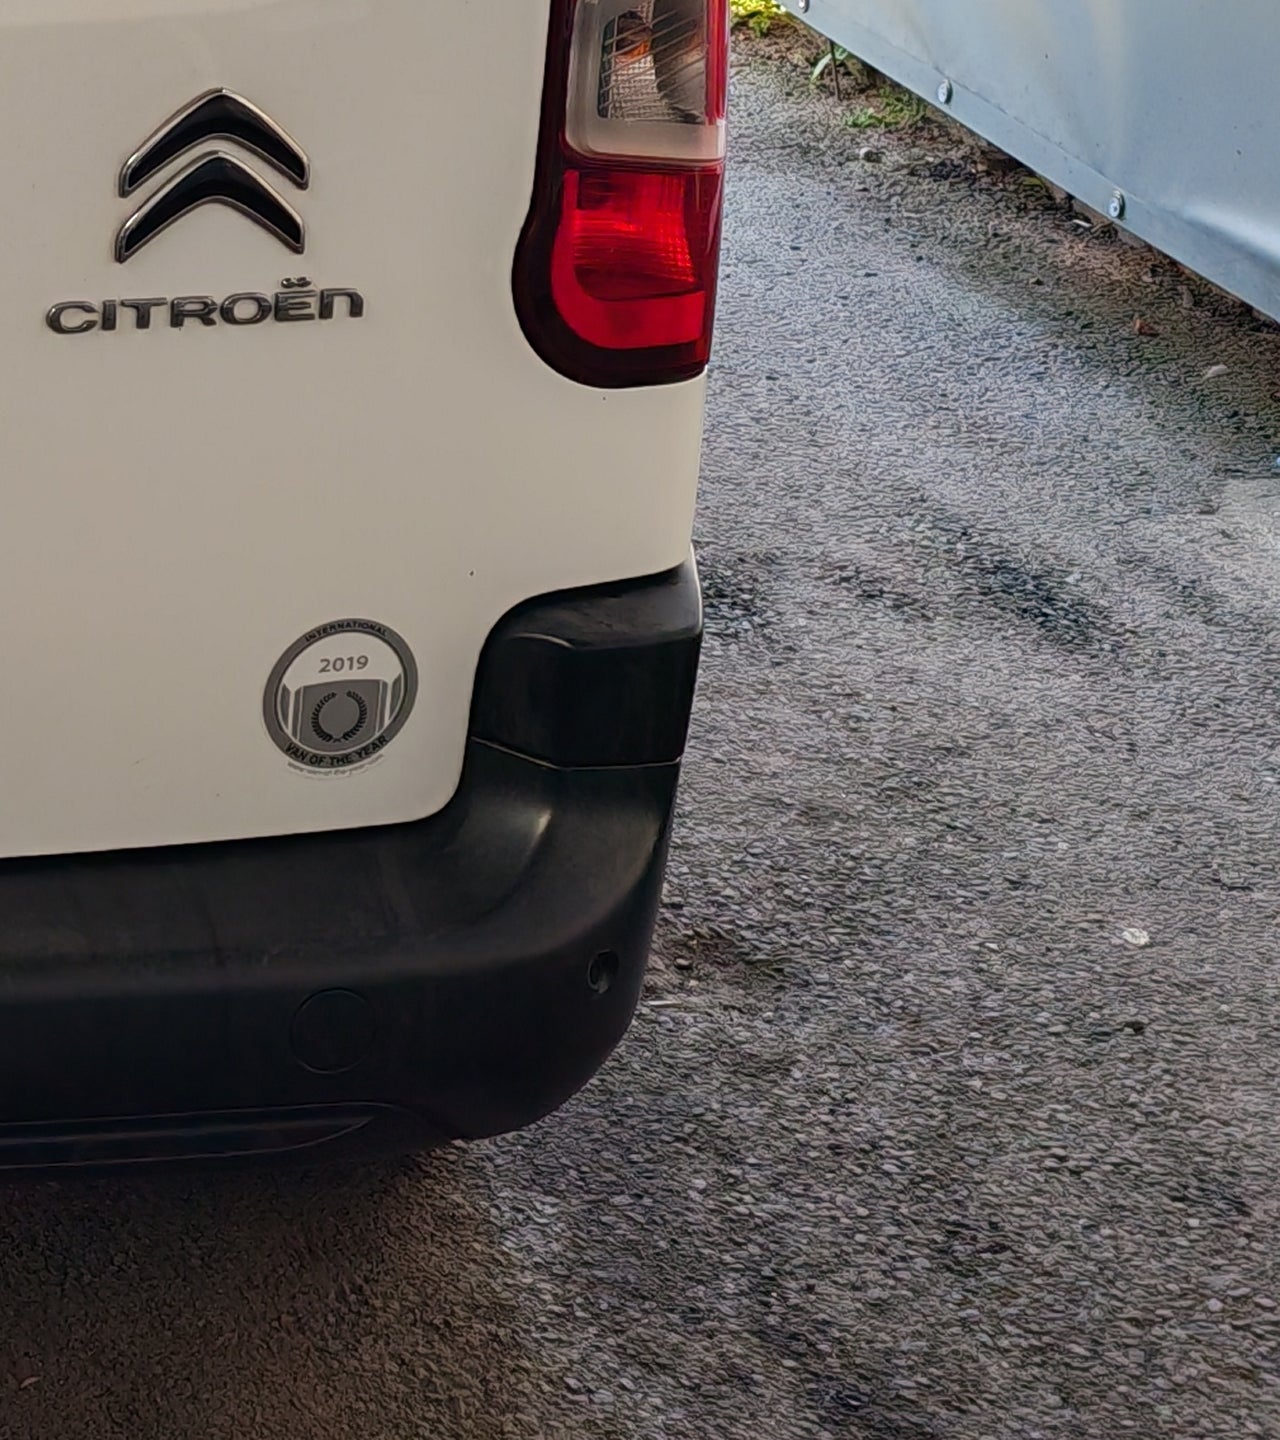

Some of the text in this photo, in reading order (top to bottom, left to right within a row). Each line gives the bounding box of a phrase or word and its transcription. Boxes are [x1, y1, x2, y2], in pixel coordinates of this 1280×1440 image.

[304, 621, 388, 642] INTERNATIONAL
[318, 655, 369, 673] 2019
[285, 735, 388, 766] VAN OF THE YEAR
